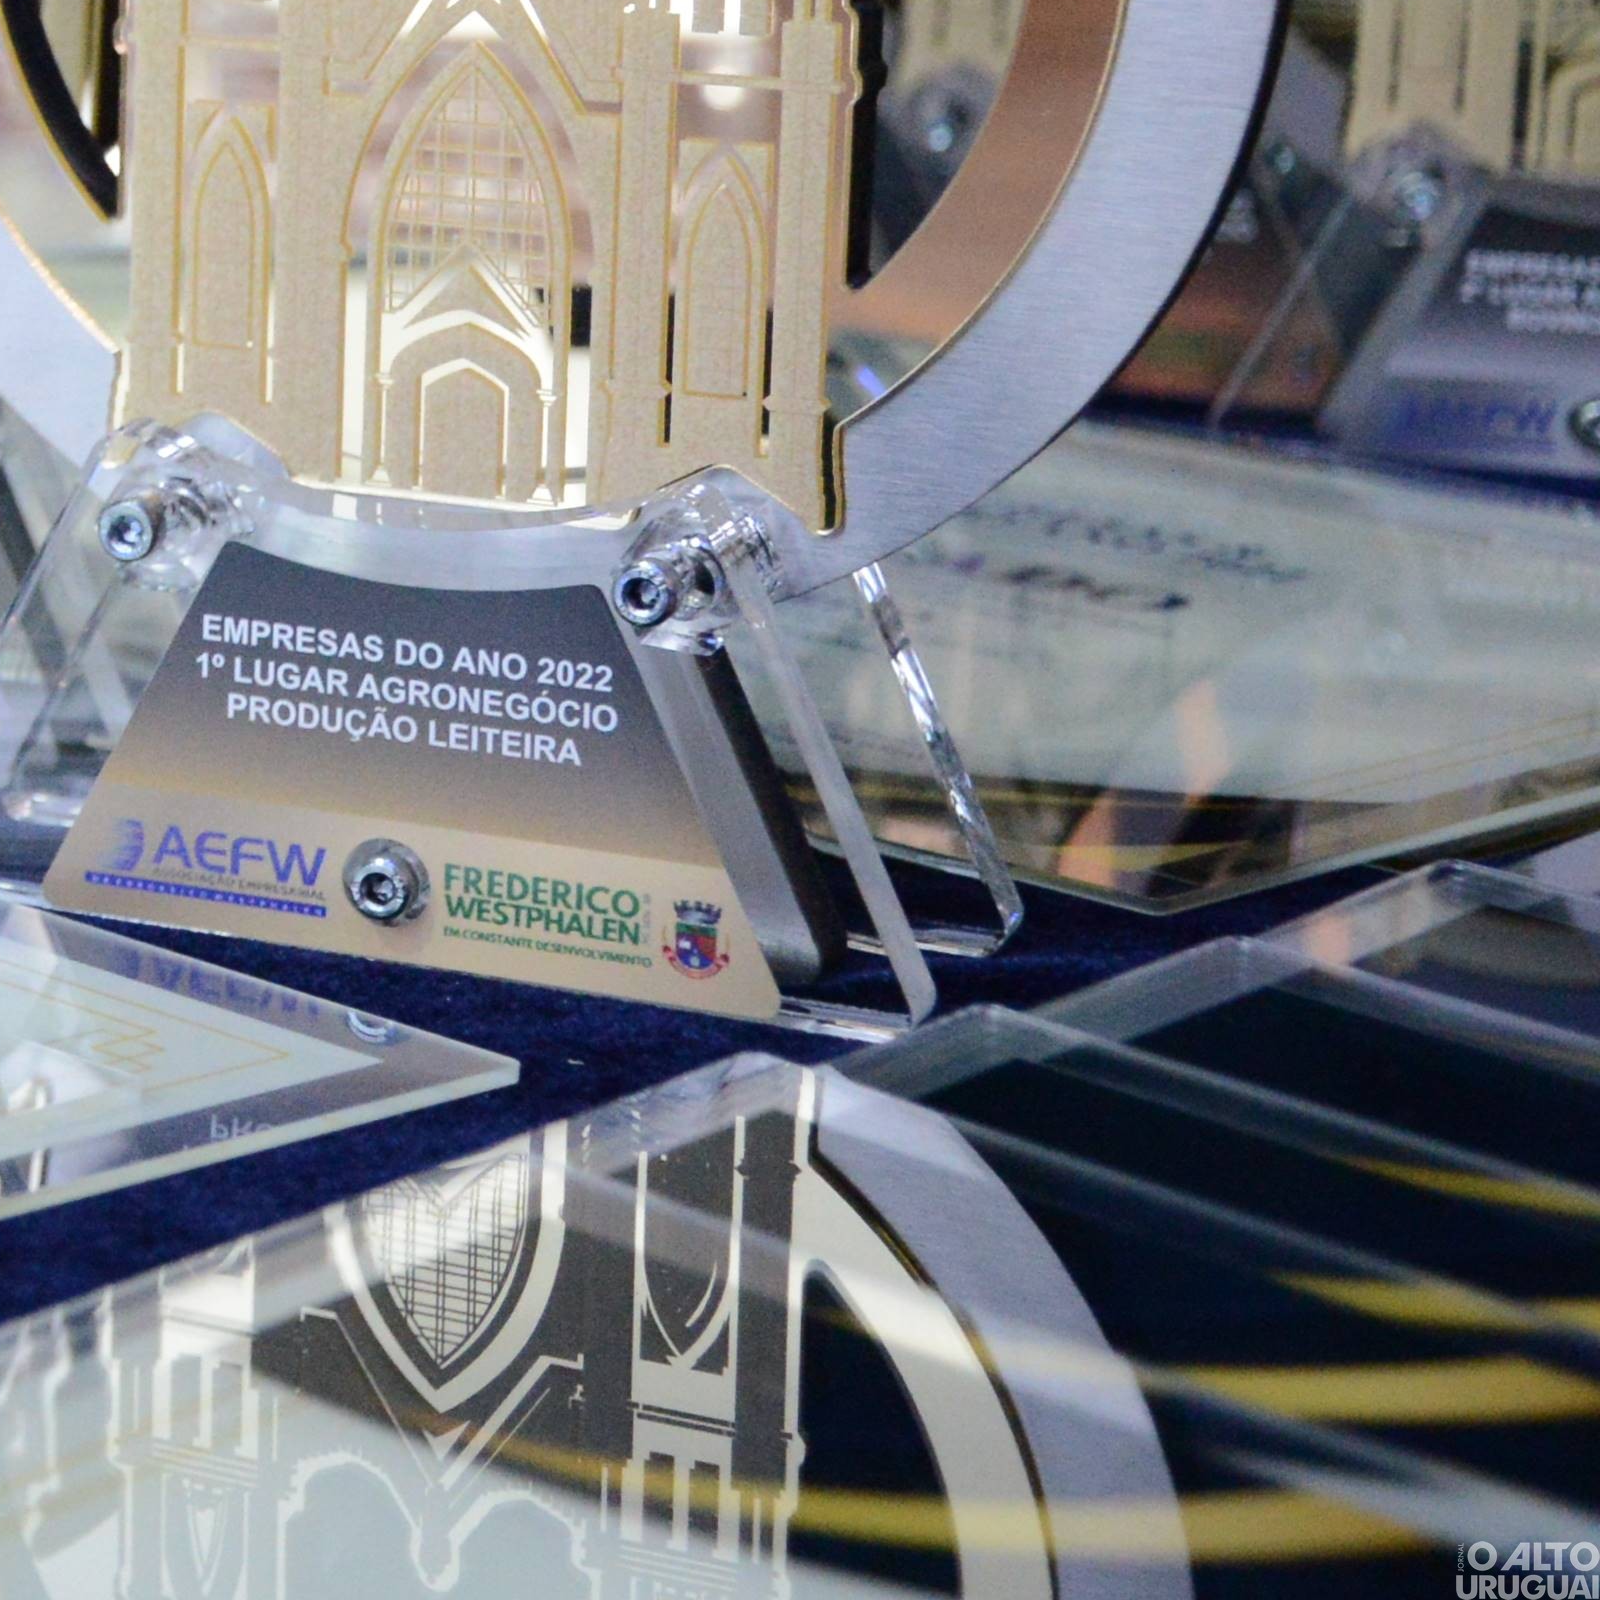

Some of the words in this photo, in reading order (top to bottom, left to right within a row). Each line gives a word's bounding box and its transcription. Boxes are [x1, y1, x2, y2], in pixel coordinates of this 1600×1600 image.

[202, 614, 384, 662] EMPRESAS
[394, 638, 445, 670] DO
[451, 647, 528, 681] ANO
[536, 658, 614, 692] 2022
[195, 652, 225, 678] 1º
[233, 656, 349, 697] LUGAR
[356, 673, 619, 733] AGRONEGÓCIO
[227, 693, 418, 743] PRODUÇÃO
[428, 719, 583, 767] LEITEIRA
[153, 824, 327, 886] AEFW
[444, 863, 639, 918] FREDERICO
[445, 894, 640, 945] WESTPHALEN
[443, 926, 461, 938] EM
[462, 928, 533, 948] CONSTANTE
[536, 939, 651, 969] DESENVOLVIMENTO
